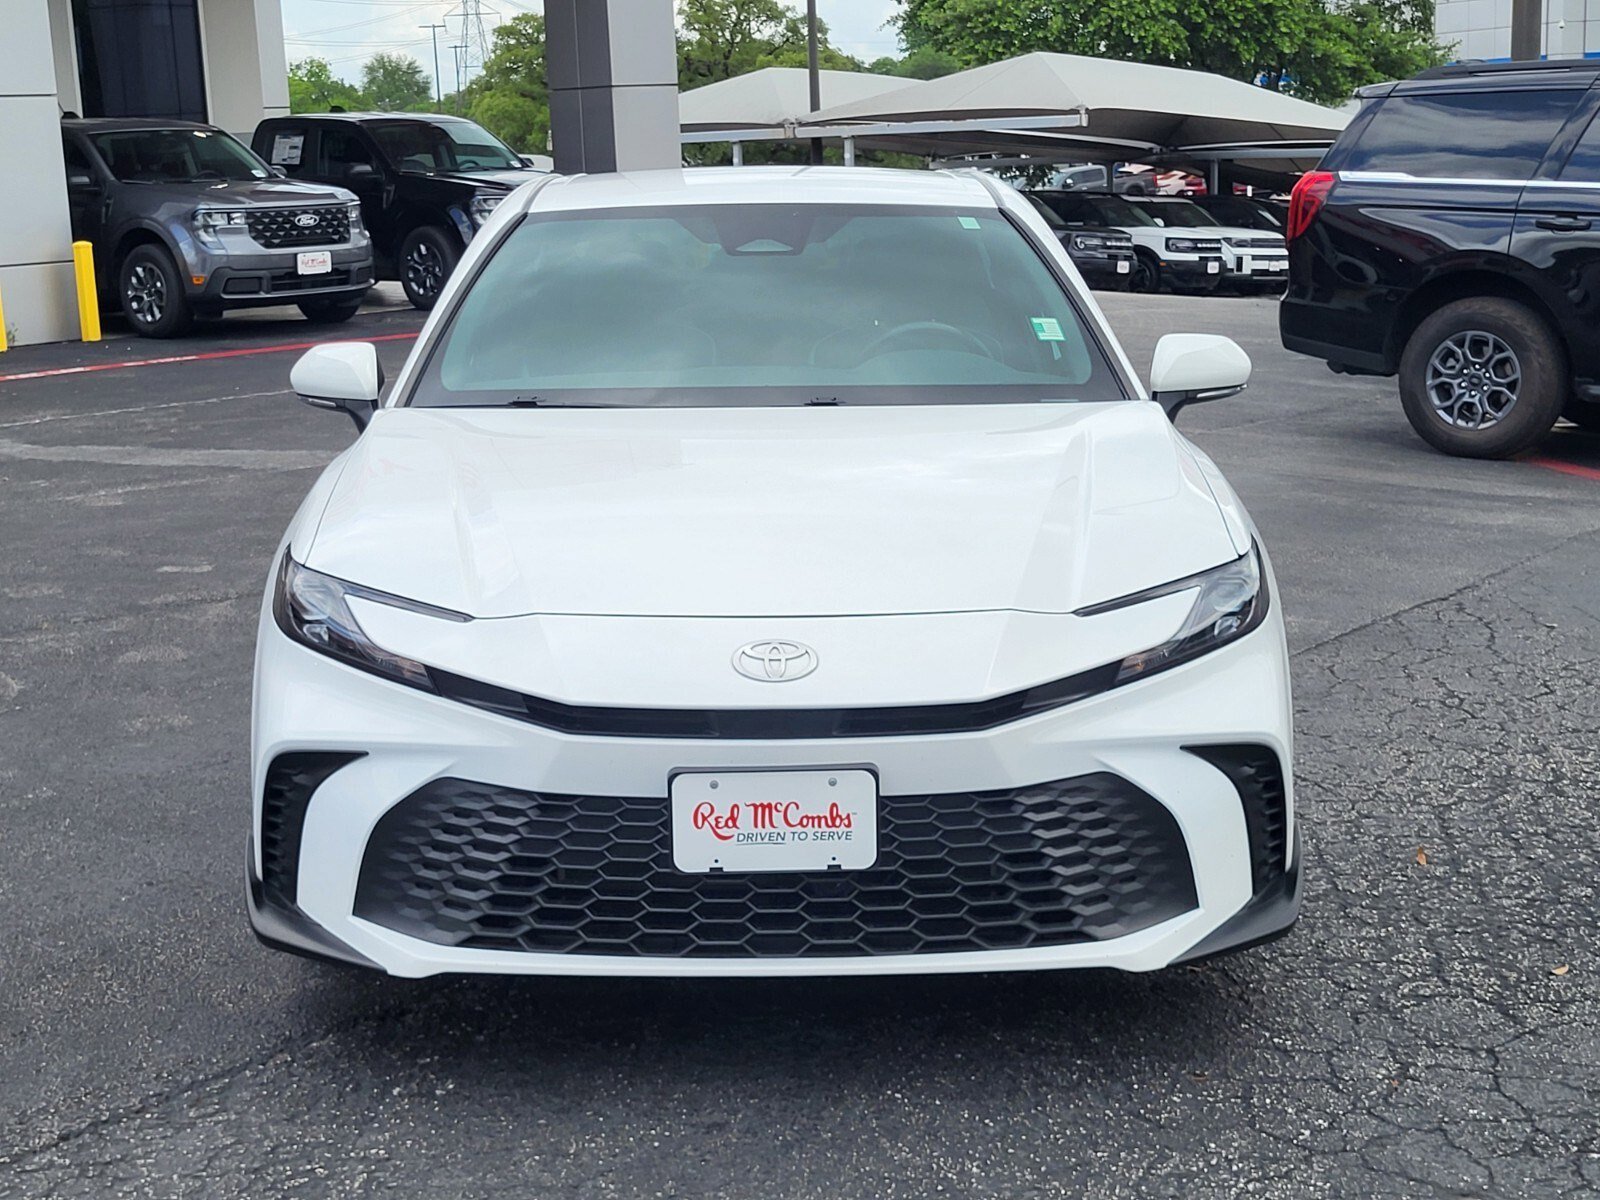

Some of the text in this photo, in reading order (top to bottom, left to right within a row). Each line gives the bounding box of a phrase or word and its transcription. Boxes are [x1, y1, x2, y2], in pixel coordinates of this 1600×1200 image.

[692, 801, 852, 841] Red McCombs
[737, 830, 853, 843] DRIVEN TO SERVE
